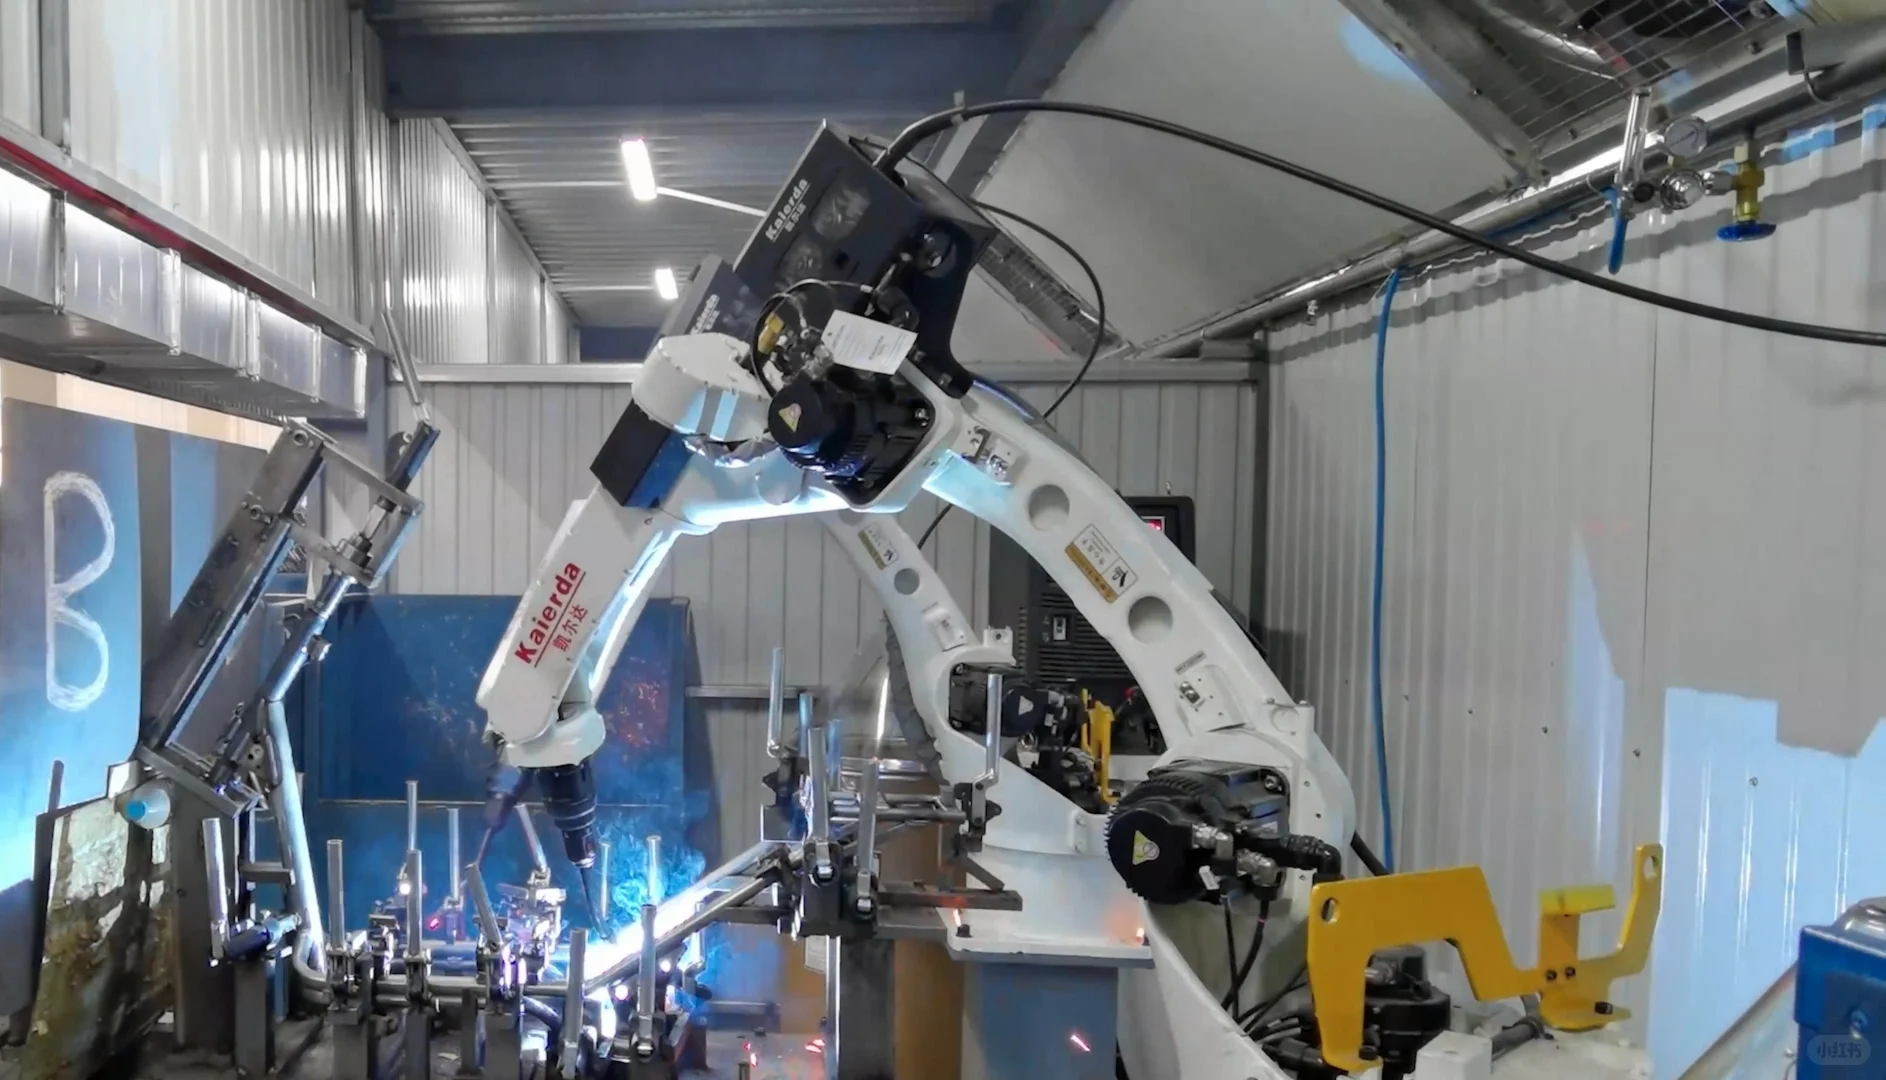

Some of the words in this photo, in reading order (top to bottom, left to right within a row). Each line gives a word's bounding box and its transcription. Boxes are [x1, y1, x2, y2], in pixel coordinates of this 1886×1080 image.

[44, 470, 115, 712] B
[514, 562, 581, 664] Kaierda
[553, 604, 588, 652] 凯尔达
